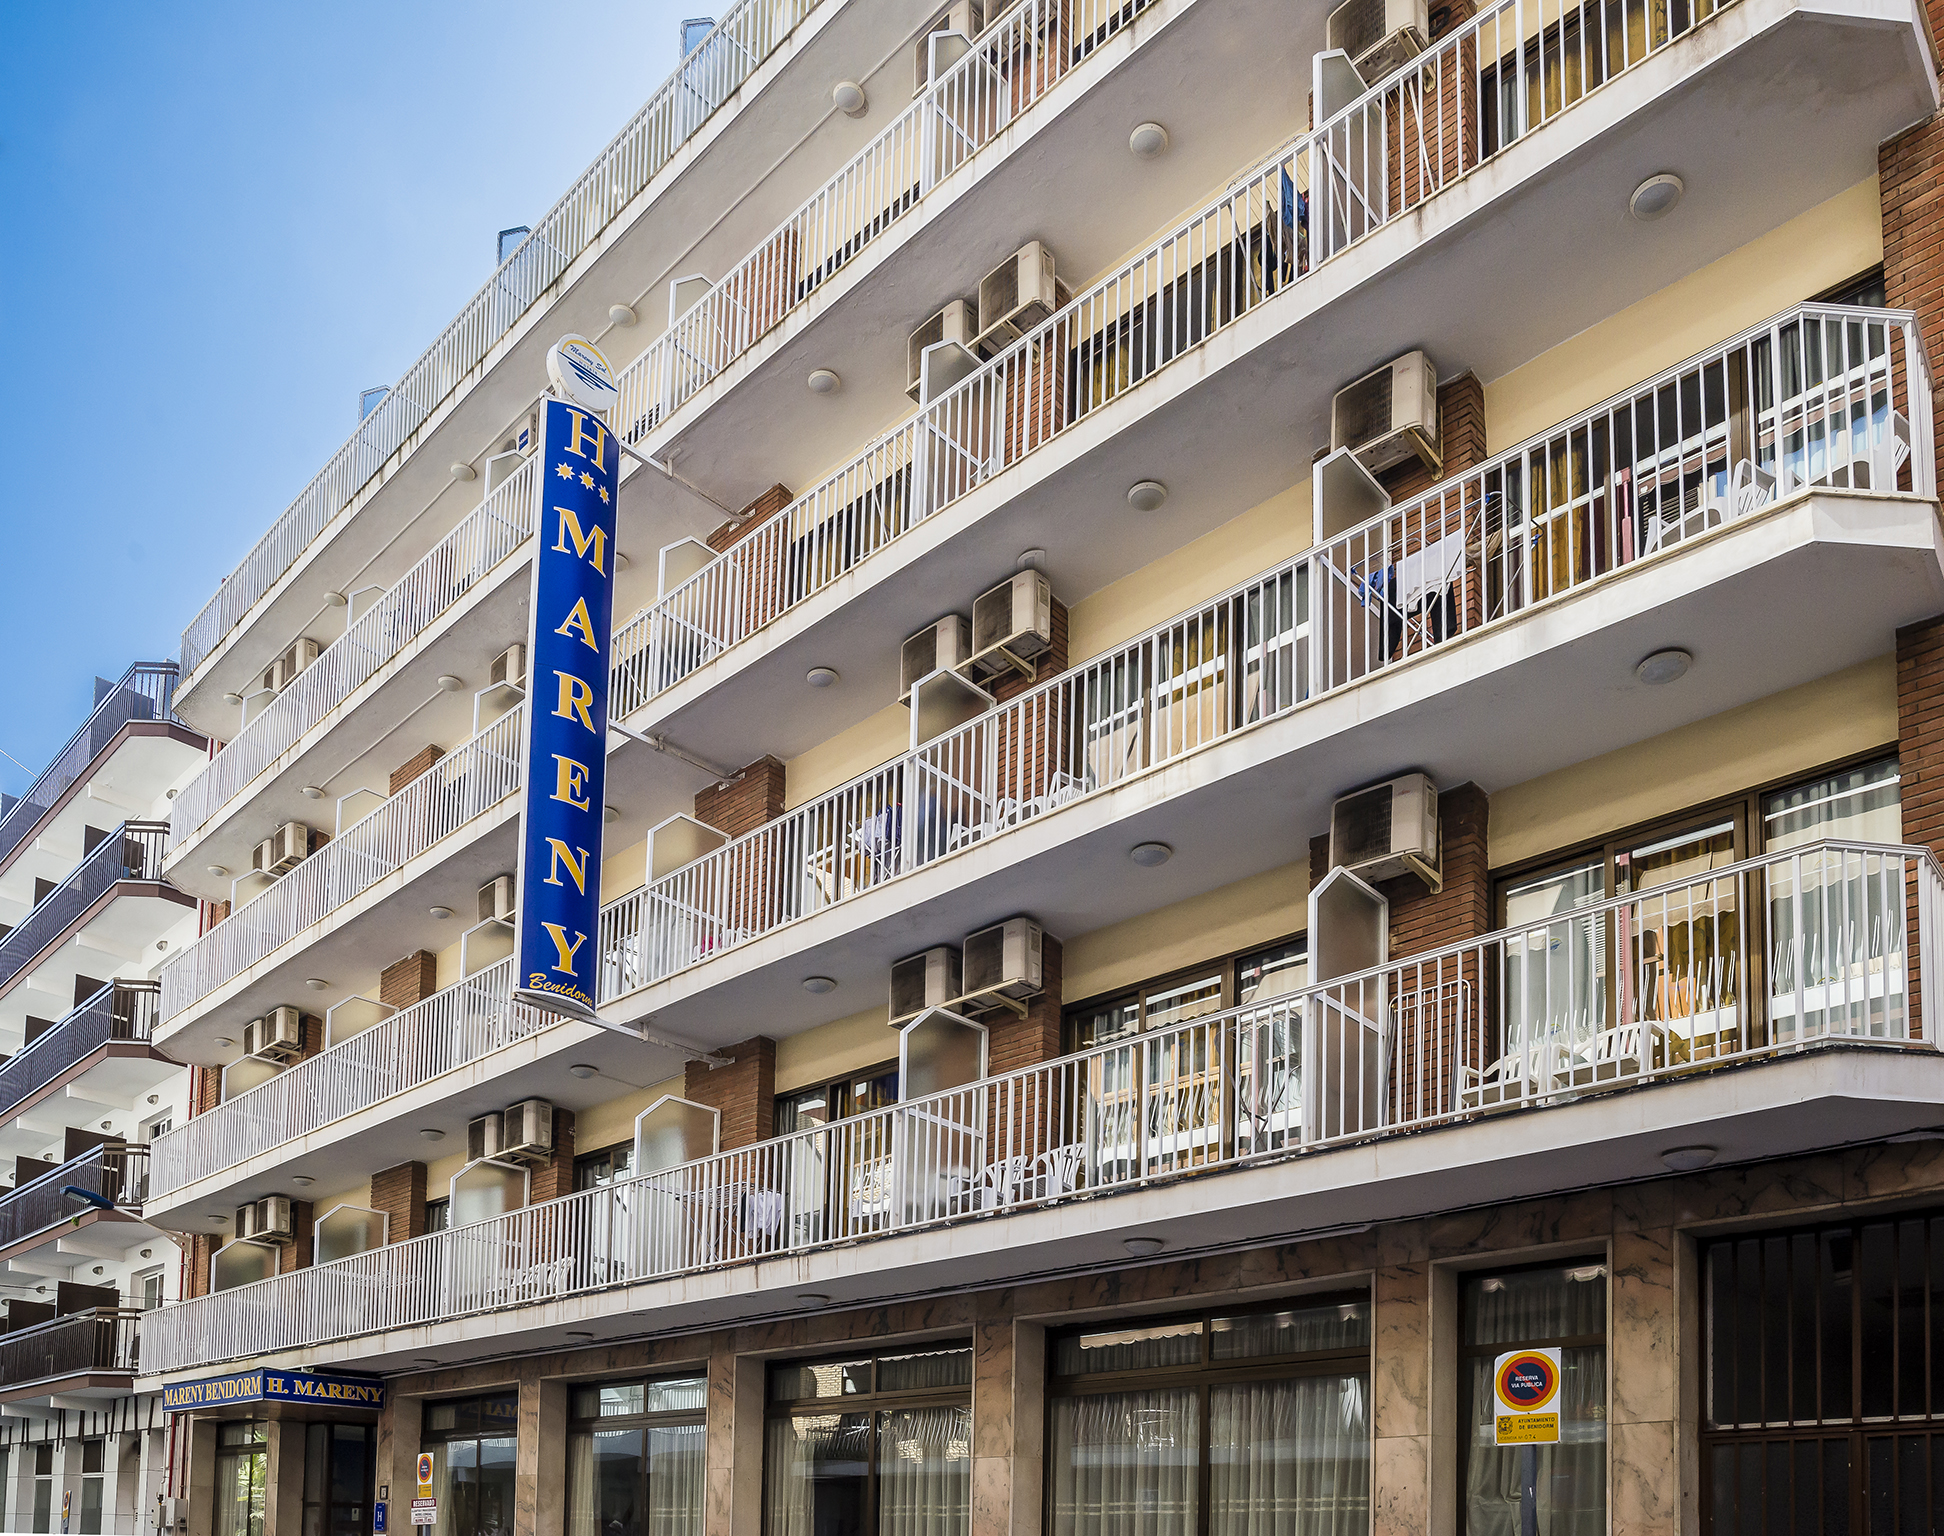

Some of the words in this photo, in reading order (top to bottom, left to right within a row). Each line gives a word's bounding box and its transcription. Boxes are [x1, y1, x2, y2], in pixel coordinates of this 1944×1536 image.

[564, 408, 609, 475] H
[541, 506, 608, 978] MARENY
[528, 972, 593, 1007] Benidorm
[164, 1384, 204, 1406] MARENY
[205, 1375, 261, 1401] BENIDORM
[266, 1377, 289, 1394] H.
[293, 1380, 384, 1402] MARENY
[413, 1499, 435, 1507] RESERVADO
